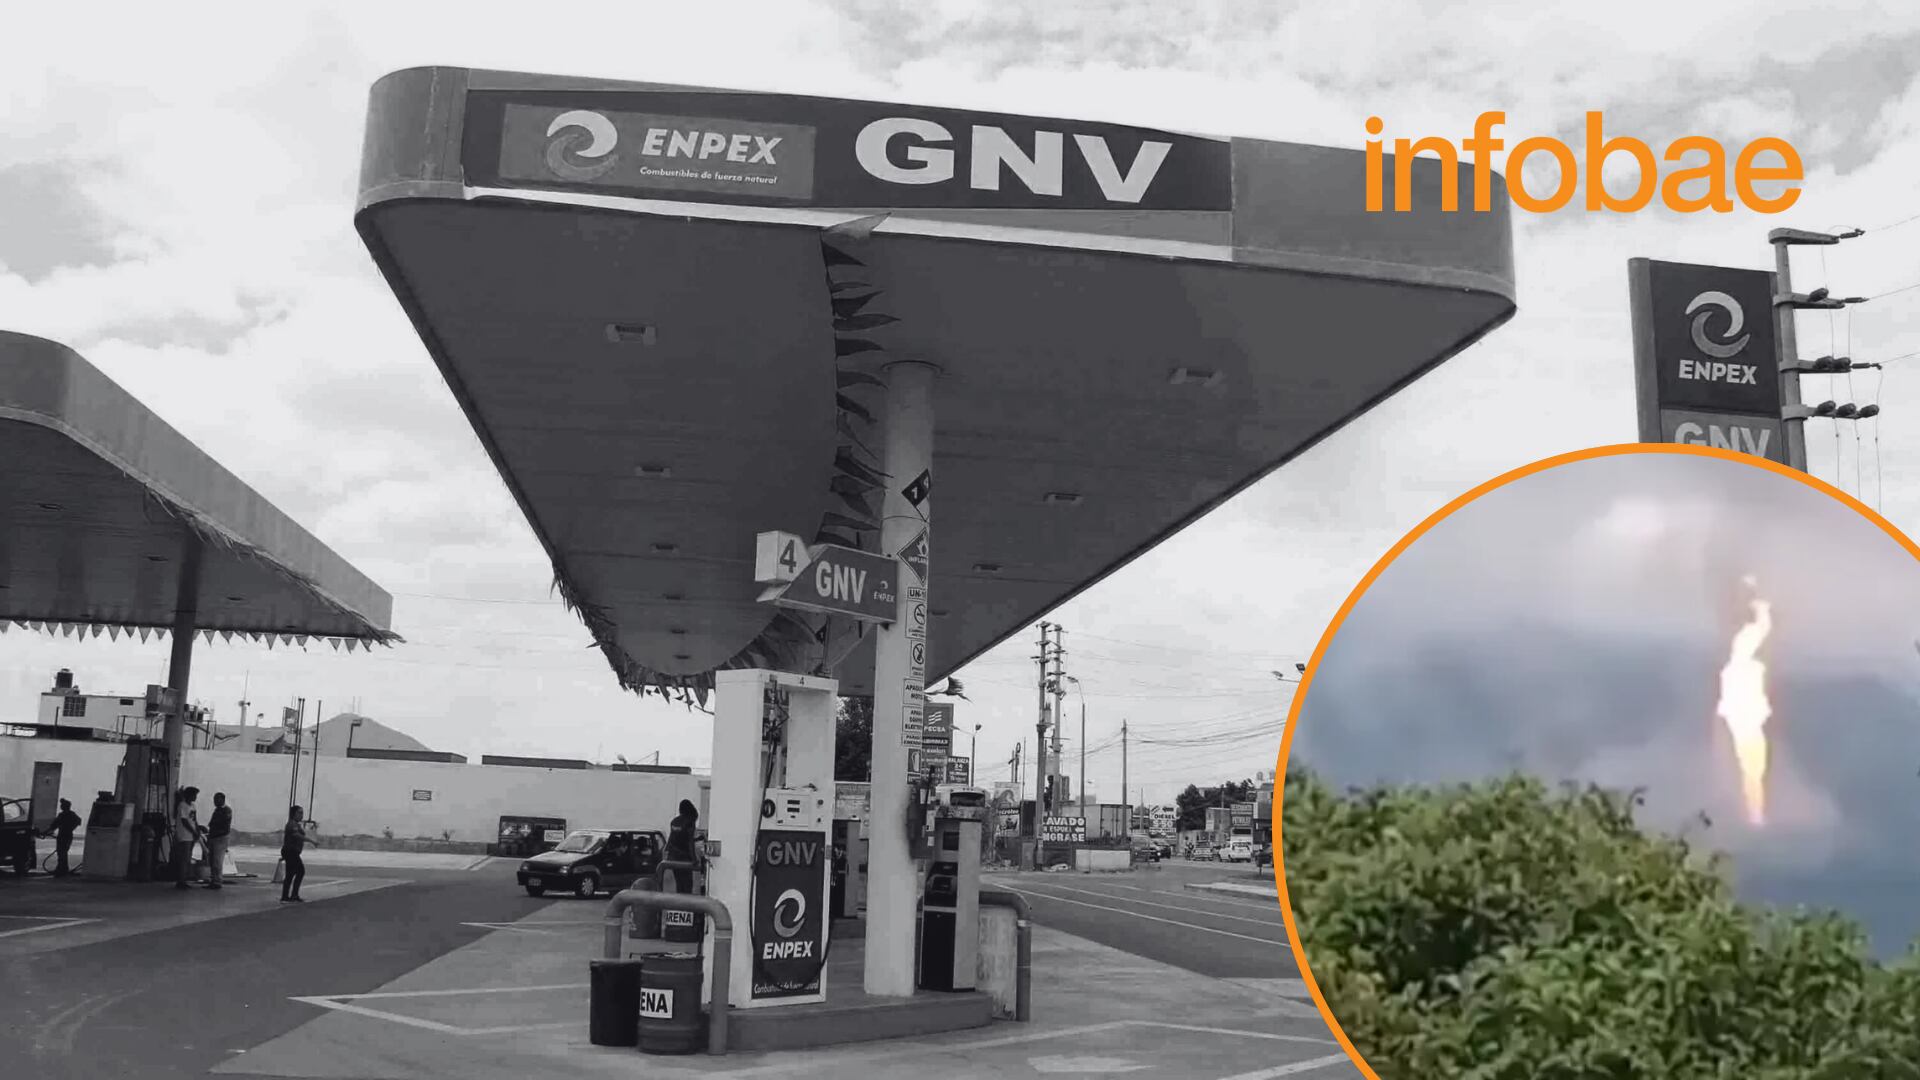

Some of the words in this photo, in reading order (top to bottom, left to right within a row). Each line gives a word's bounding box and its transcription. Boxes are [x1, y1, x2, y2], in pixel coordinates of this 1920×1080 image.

[641, 128, 783, 164] ENPEX
[855, 118, 1173, 203] GNV
[639, 166, 699, 179] Combustibles
[700, 171, 712, 180] de
[714, 172, 743, 182] fuerza
[745, 176, 778, 185] natural
[1678, 359, 1757, 385] ENPEX
[1674, 422, 1771, 458] GNV
[911, 486, 918, 499] 1
[779, 539, 797, 573] 4
[816, 561, 867, 603] GNV
[873, 591, 895, 603] ENPEX
[766, 841, 817, 865] GNV
[763, 941, 813, 959] ENPEX
